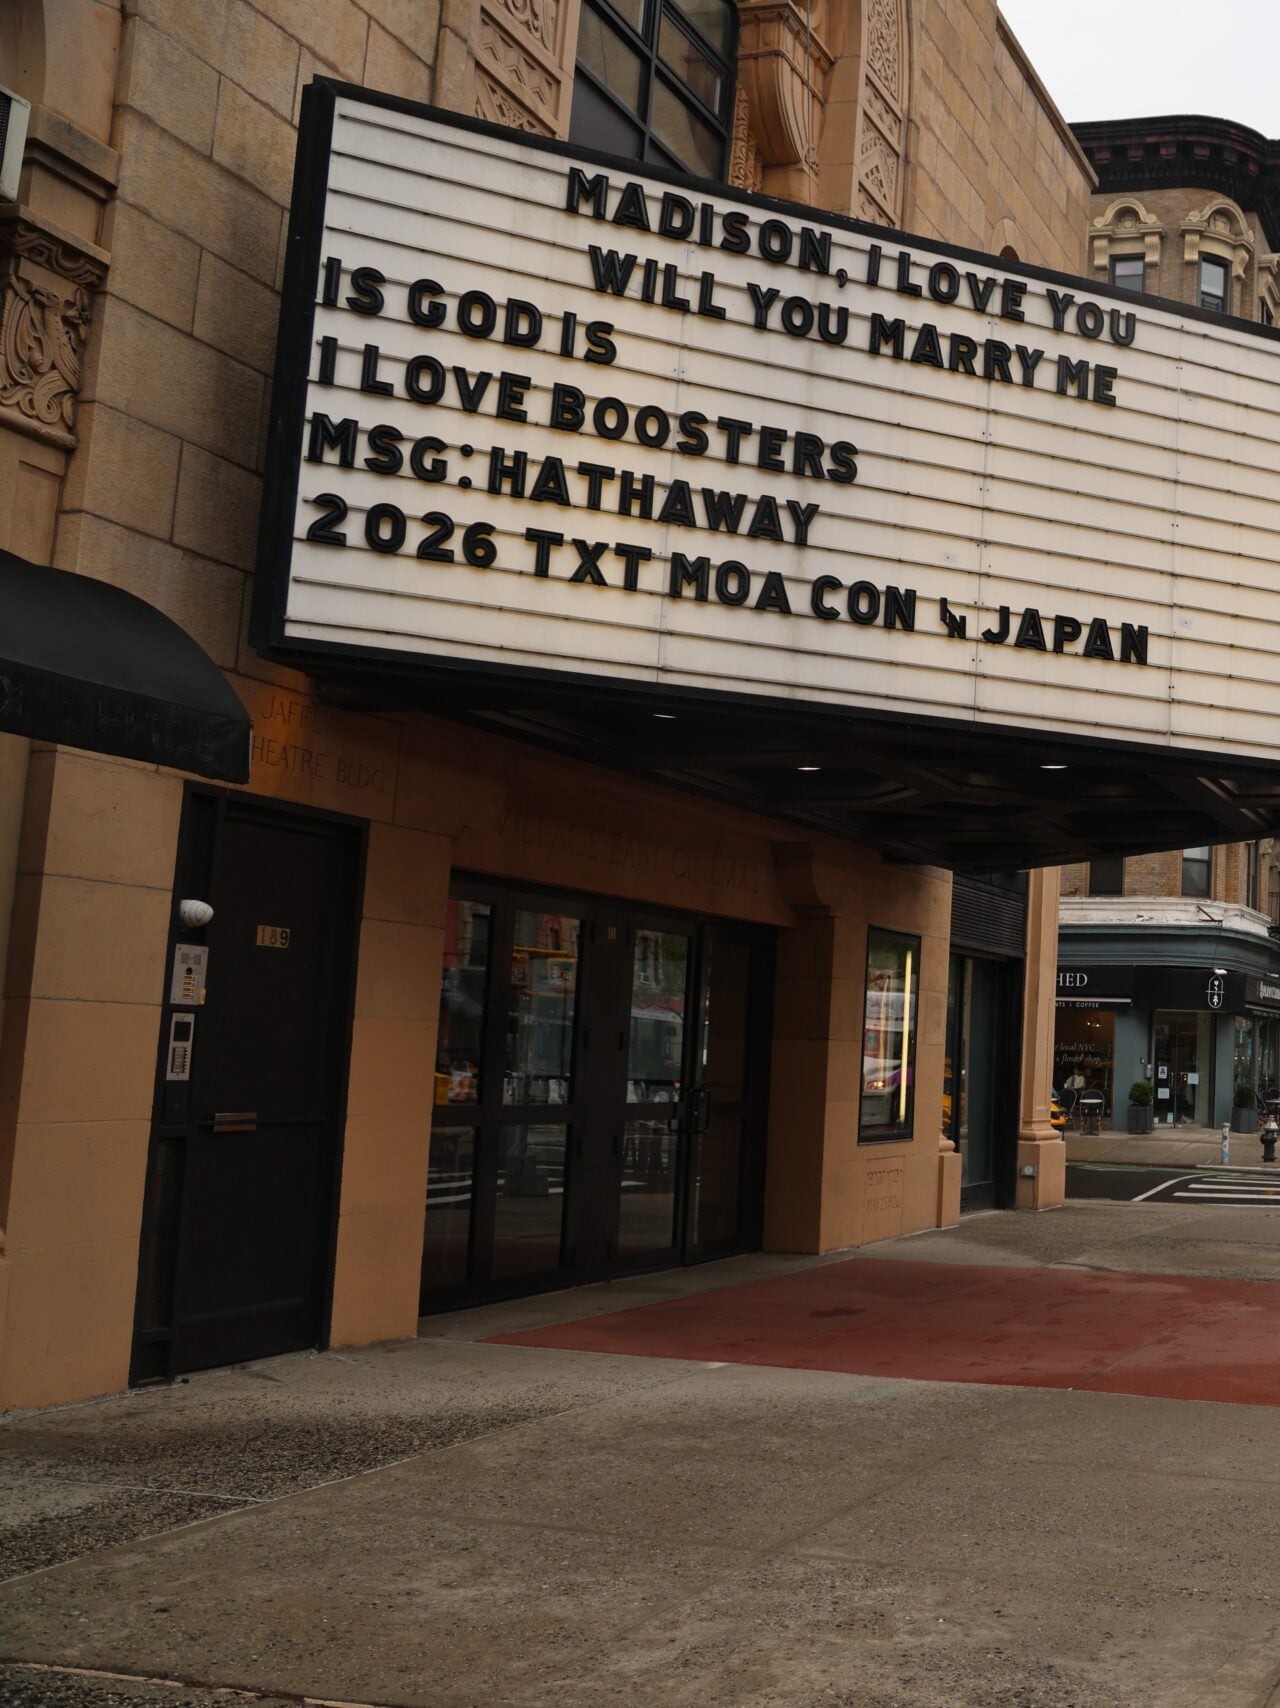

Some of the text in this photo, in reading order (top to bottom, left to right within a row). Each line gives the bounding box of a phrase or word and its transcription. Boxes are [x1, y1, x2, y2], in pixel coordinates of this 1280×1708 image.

[321, 256, 618, 366] IS GOD IS
[566, 166, 1137, 348] MADISON, I LOVE YOU
[587, 244, 1119, 408] WILL YOU MARRY ME
[319, 335, 859, 485] I LOVE BOOSTERS
[306, 492, 1150, 666] 2026 TXT MOA CON IN JAPAN
[252, 734, 385, 793] HEATRE BLDG
[261, 927, 289, 947] 189
[1075, 1001, 1100, 1009] COFFEE
